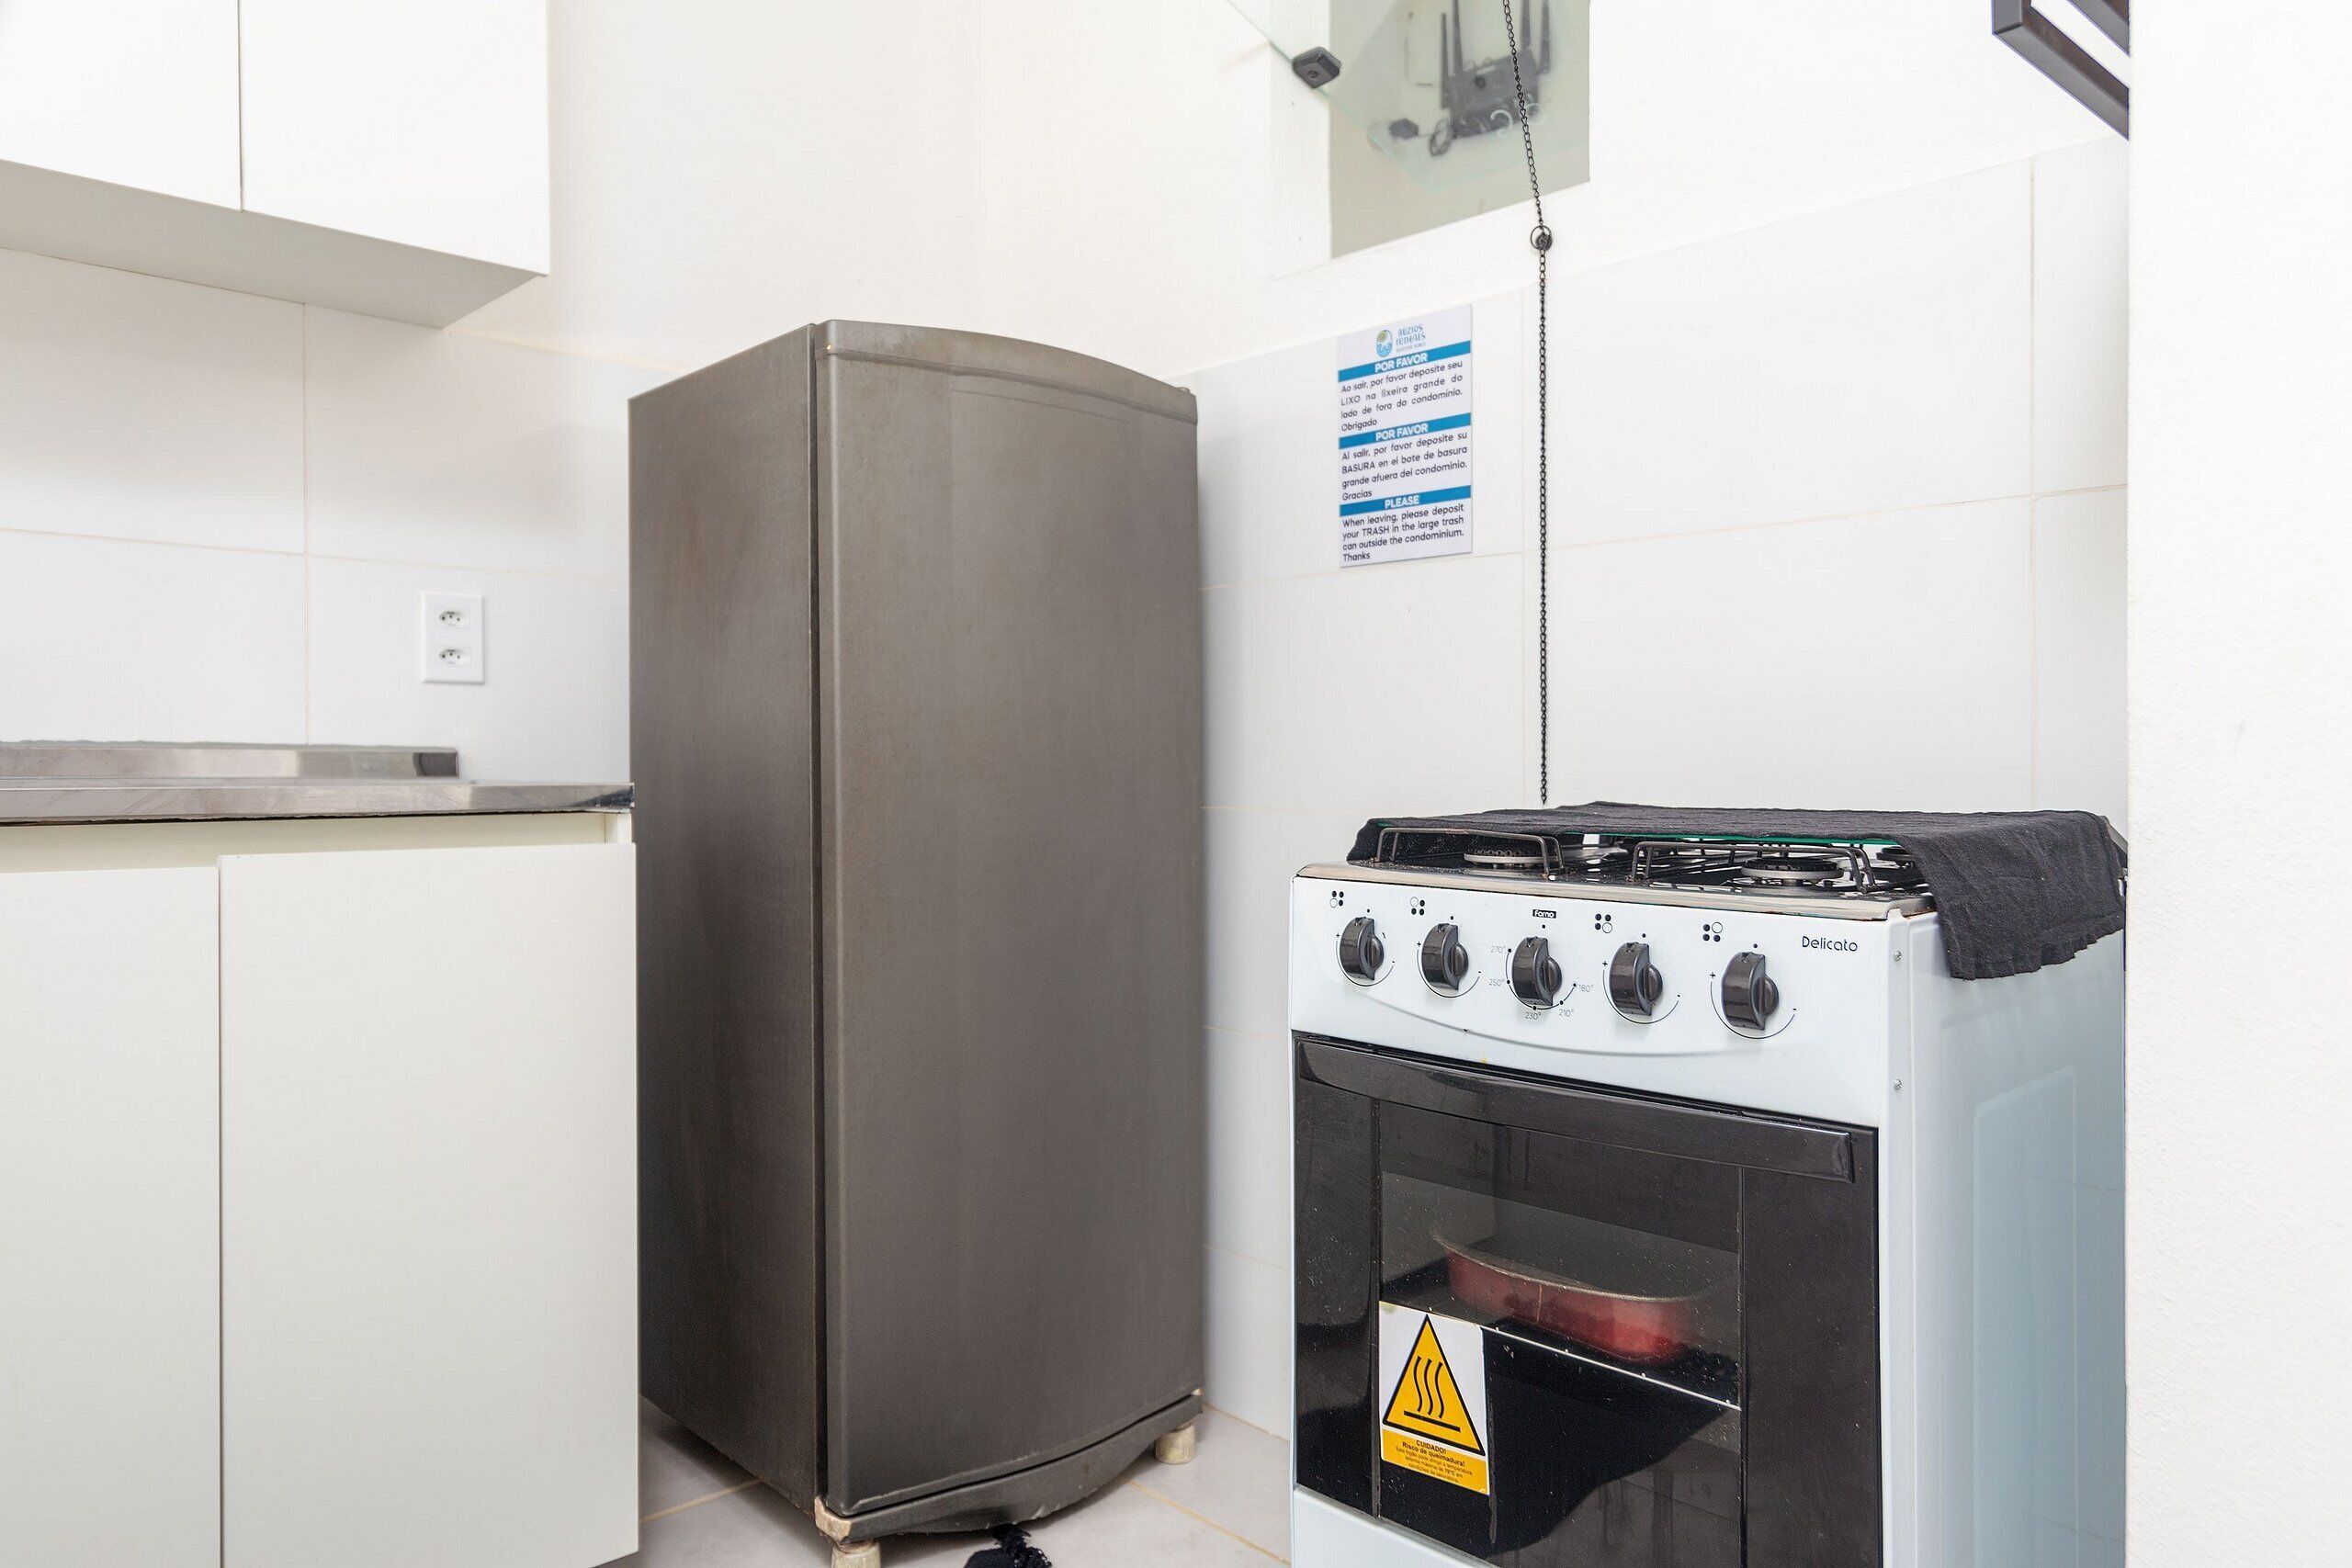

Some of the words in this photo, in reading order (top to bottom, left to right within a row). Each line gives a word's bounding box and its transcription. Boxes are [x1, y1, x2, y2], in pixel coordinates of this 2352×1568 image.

[1374, 358, 1395, 373] POR
[1396, 353, 1428, 369] FAVOR
[1341, 385, 1351, 393] Ao
[1371, 378, 1384, 389] por
[1386, 373, 1407, 384] favor
[1409, 365, 1445, 378] deposite
[1448, 361, 1463, 369] seu
[1341, 395, 1360, 406] LIXO
[1382, 386, 1408, 398] lixeira
[1413, 378, 1445, 393] grande
[1452, 374, 1463, 383] do
[1341, 409, 1358, 419] lado
[1362, 406, 1372, 414] de
[1376, 403, 1392, 412] fora
[1341, 418, 1377, 432] Obrigado
[1375, 430, 1395, 441] POR
[1396, 423, 1428, 439] FAVOR
[1342, 452, 1350, 461] Al
[1352, 449, 1370, 459] salir,
[1374, 446, 1387, 457] por
[1391, 441, 1412, 452] favor
[1417, 434, 1453, 447] deposite
[1342, 461, 1375, 474] BASURA
[1378, 460, 1388, 468] en
[1391, 457, 1398, 465] el
[1401, 454, 1420, 464] bote
[1424, 450, 1434, 459] de
[1437, 446, 1467, 457] basura
[1342, 476, 1369, 490] grande
[1372, 472, 1398, 483] afuera
[1400, 468, 1412, 478] del
[1342, 489, 1373, 501] Gracias
[1384, 495, 1419, 509] PLEASE
[1342, 518, 1364, 527] When
[1367, 513, 1398, 525] leaving,
[1401, 509, 1429, 520] please
[1431, 503, 1464, 516] deposit
[1342, 531, 1360, 541] your
[1362, 525, 1389, 536] TRASH
[1393, 524, 1399, 533] in
[1402, 522, 1415, 531] the
[1418, 520, 1439, 530] large
[1442, 516, 1464, 525] trash
[1343, 542, 1357, 550] can
[1359, 537, 1387, 548] outside
[1390, 536, 1403, 545] the
[1405, 528, 1464, 542] condominium.
[1343, 552, 1371, 562] Thanks
[1803, 935, 1858, 952] Delicato
[1402, 1441, 1419, 1451] Risco
[1429, 1451, 1464, 1467] queimadura!
[1416, 1439, 1446, 1454] CUIDADO!
